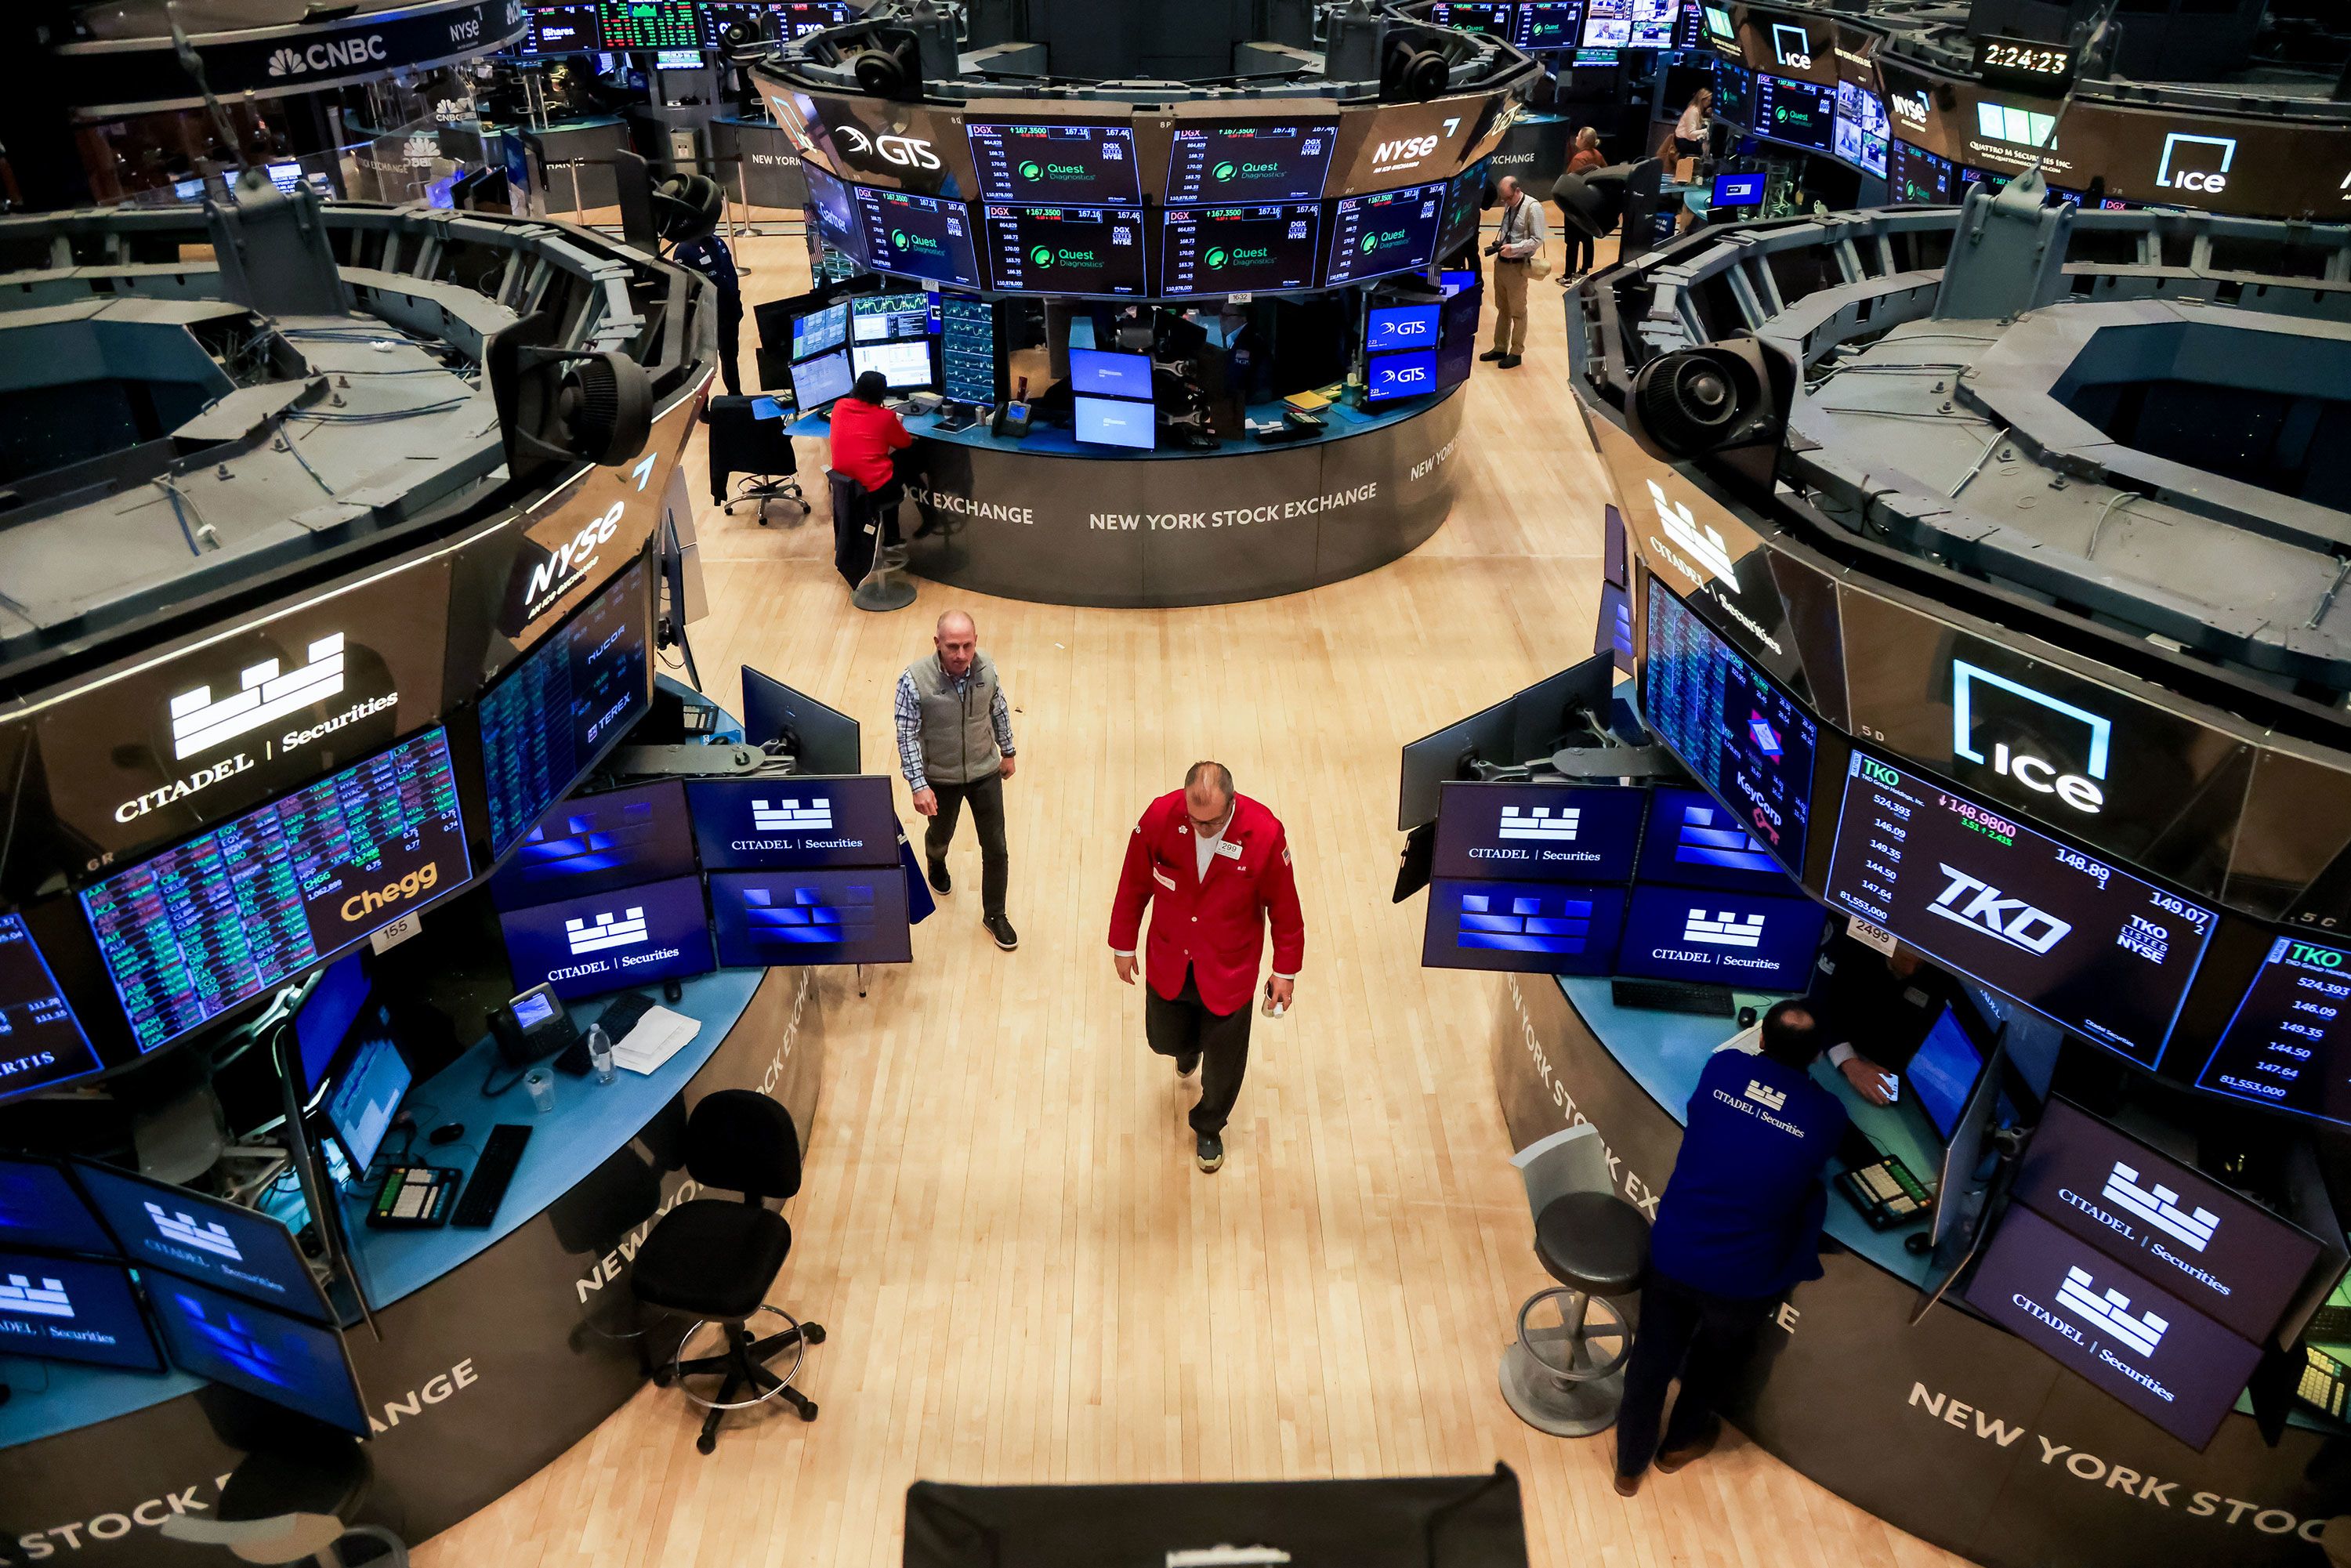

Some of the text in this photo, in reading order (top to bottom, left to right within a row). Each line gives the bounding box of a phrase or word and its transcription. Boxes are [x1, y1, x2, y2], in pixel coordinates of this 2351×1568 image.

[306, 35, 387, 71] CNBC
[1984, 45, 2067, 74] 2:24:23
[752, 154, 801, 166] NEW YORK
[876, 135, 940, 169] GTS
[1048, 164, 1084, 174] Quest
[1242, 162, 1278, 172] Quest
[886, 194, 908, 203] 167.3500
[1342, 194, 1393, 209] DGX 167.3500
[2106, 201, 2126, 211] DGX
[1171, 212, 1190, 220] DGX
[911, 234, 937, 248] Quest
[1382, 229, 1406, 242] Quest
[1059, 248, 1094, 259] Quest
[1233, 247, 1267, 258] Quest
[1233, 257, 1275, 266] Diagnostics
[1411, 437, 1454, 482] NEW YORK
[933, 492, 1033, 525] EXCHANGE
[1089, 482, 1378, 531] NEW YORK STOCK EXCHANGE
[1650, 537, 1781, 654] CITADEL Securities
[599, 692, 631, 729] TEREX
[1862, 725, 1886, 742] 5 D
[115, 691, 399, 823] CITADEL Securities
[1874, 779, 1890, 791] Group
[1737, 772, 1781, 825] KeyCorp
[1874, 794, 1911, 817] 524,393
[444, 820, 458, 832] 0.74
[1875, 818, 1907, 838] 146.09
[1962, 817, 2012, 846] 3.51 2.41%
[732, 838, 863, 850] CITADEL Securities
[1222, 842, 1237, 853] 299
[1864, 759, 1900, 786] TKO
[1949, 799, 2016, 838] 148.9800
[2055, 848, 2110, 881] 148.89
[2149, 892, 2209, 925] 149.07
[1870, 839, 1901, 859] 149.35
[1469, 848, 1601, 861] CITADEL Securities
[303, 871, 331, 890] CHGG
[1866, 860, 1897, 880] 144.50
[341, 862, 438, 922] Chegg
[1862, 880, 1892, 900] 147.64
[1840, 890, 1888, 920] 81,553,000
[1936, 862, 2072, 954] TKO
[383, 920, 408, 939] 155
[2130, 914, 2168, 940] TKO
[2301, 912, 2337, 927] 5 C
[1856, 921, 1890, 943] 2499
[2121, 926, 2168, 952] LISTED
[1652, 948, 1780, 970] CITADEL Securities
[2117, 935, 2165, 965] NYSE
[2292, 943, 2342, 968] TKO
[548, 947, 679, 982] CITADEL Securities
[2297, 977, 2350, 997] 524,393
[2292, 1001, 2337, 1017] 146.09
[2085, 1019, 2135, 1048] Citadel Securities
[2280, 1021, 2324, 1038] 149.35
[1522, 1004, 1552, 1089] YORK
[2267, 1041, 2311, 1058] 144.50
[2256, 1061, 2299, 1077] 147.64
[2219, 1074, 2286, 1097] 81,553,000
[1713, 1088, 1805, 1139] CITADEL Securities
[2058, 1188, 2231, 1297] CITADEL Securities
[576, 1220, 648, 1304] NEW
[49, 1326, 117, 1345] Securities
[2012, 1293, 2175, 1403] CITADEL Securities
[1908, 1381, 2024, 1447] NEW
[2038, 1435, 2182, 1506] YORK
[19, 1486, 208, 1560] STOCK
